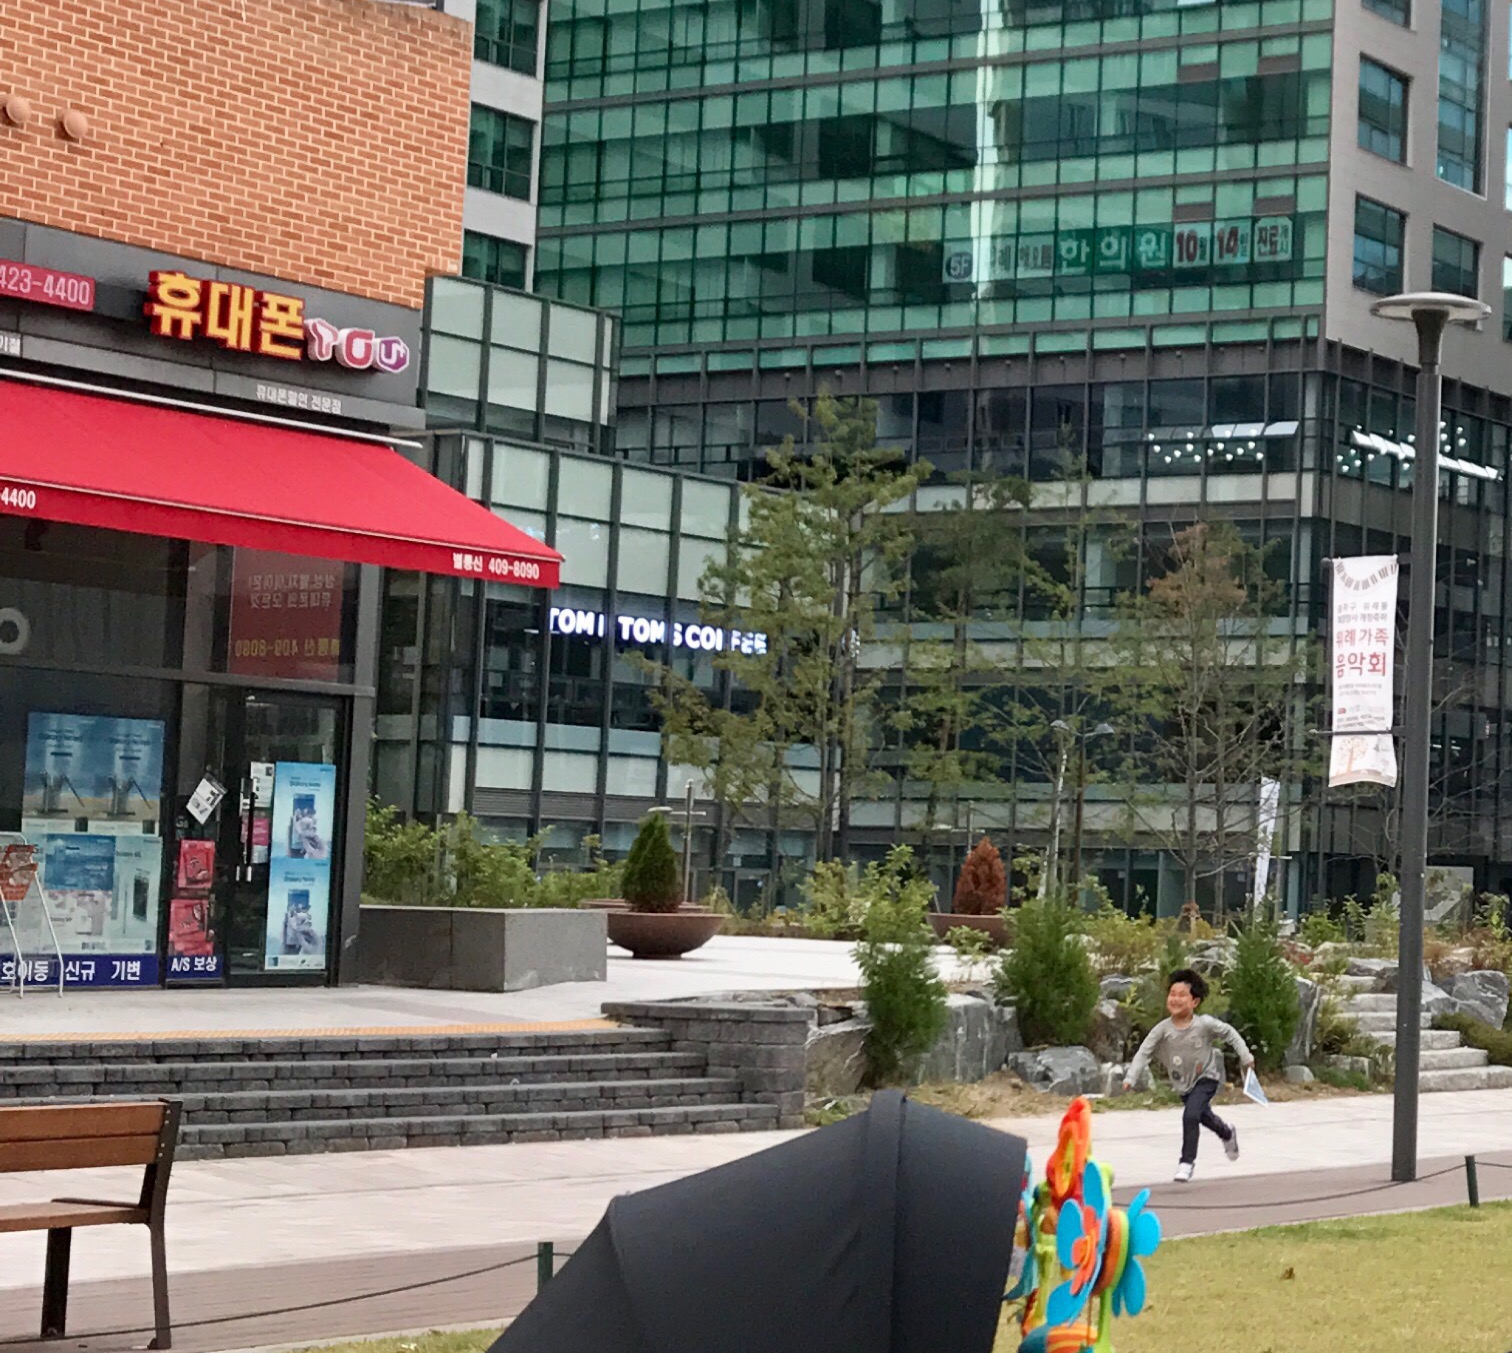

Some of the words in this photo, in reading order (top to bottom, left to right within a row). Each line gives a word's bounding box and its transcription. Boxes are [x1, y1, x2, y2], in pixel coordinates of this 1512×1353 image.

[1060, 231, 1168, 274] 한의원
[152, 271, 305, 361] 휴대폰
[488, 557, 541, 580] 409-8090
[1335, 651, 1387, 679] 음악회
[64, 959, 96, 982] 신규
[111, 959, 141, 981] 기변
[170, 956, 190, 972] A/S
[193, 955, 218, 972] 보상
